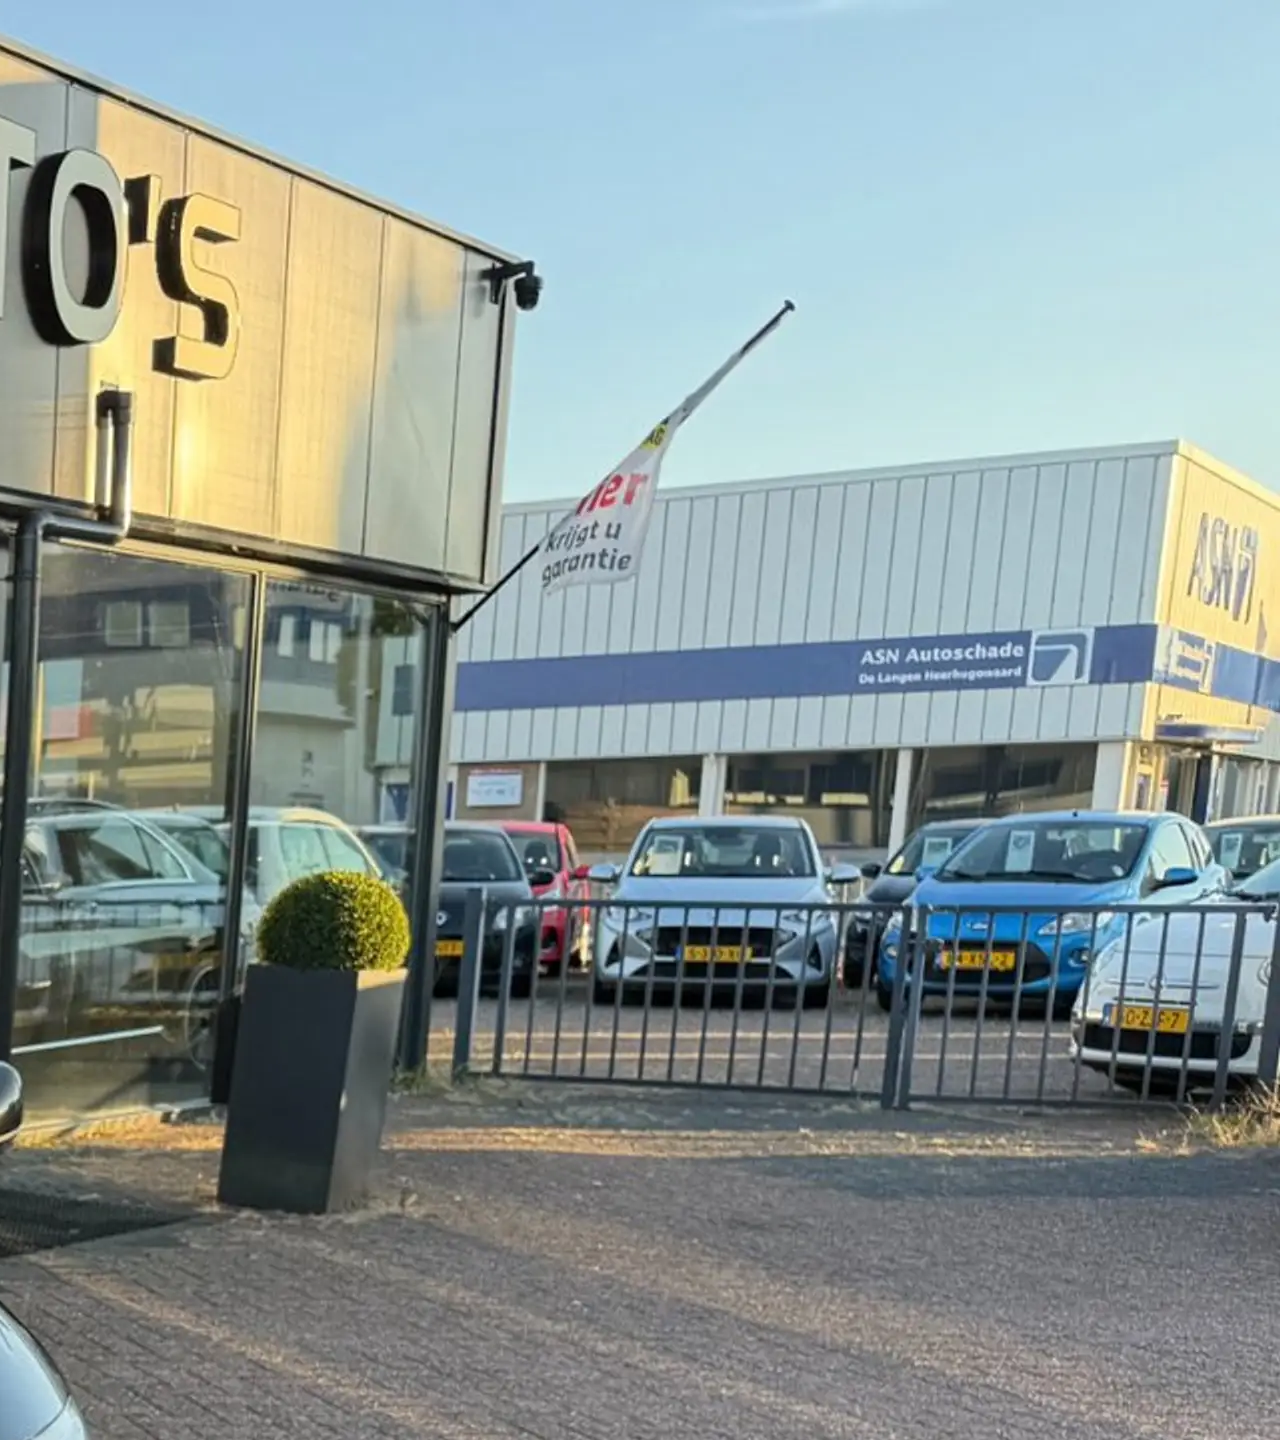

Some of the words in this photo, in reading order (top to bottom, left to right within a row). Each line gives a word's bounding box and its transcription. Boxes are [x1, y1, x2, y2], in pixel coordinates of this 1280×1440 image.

[544, 518, 599, 554] krijgt
[605, 522, 622, 541] u
[542, 547, 632, 588] garantie
[1187, 512, 1238, 612] ASN
[861, 648, 900, 666] ASN
[905, 641, 1025, 662] Autoschade
[859, 673, 875, 684] De
